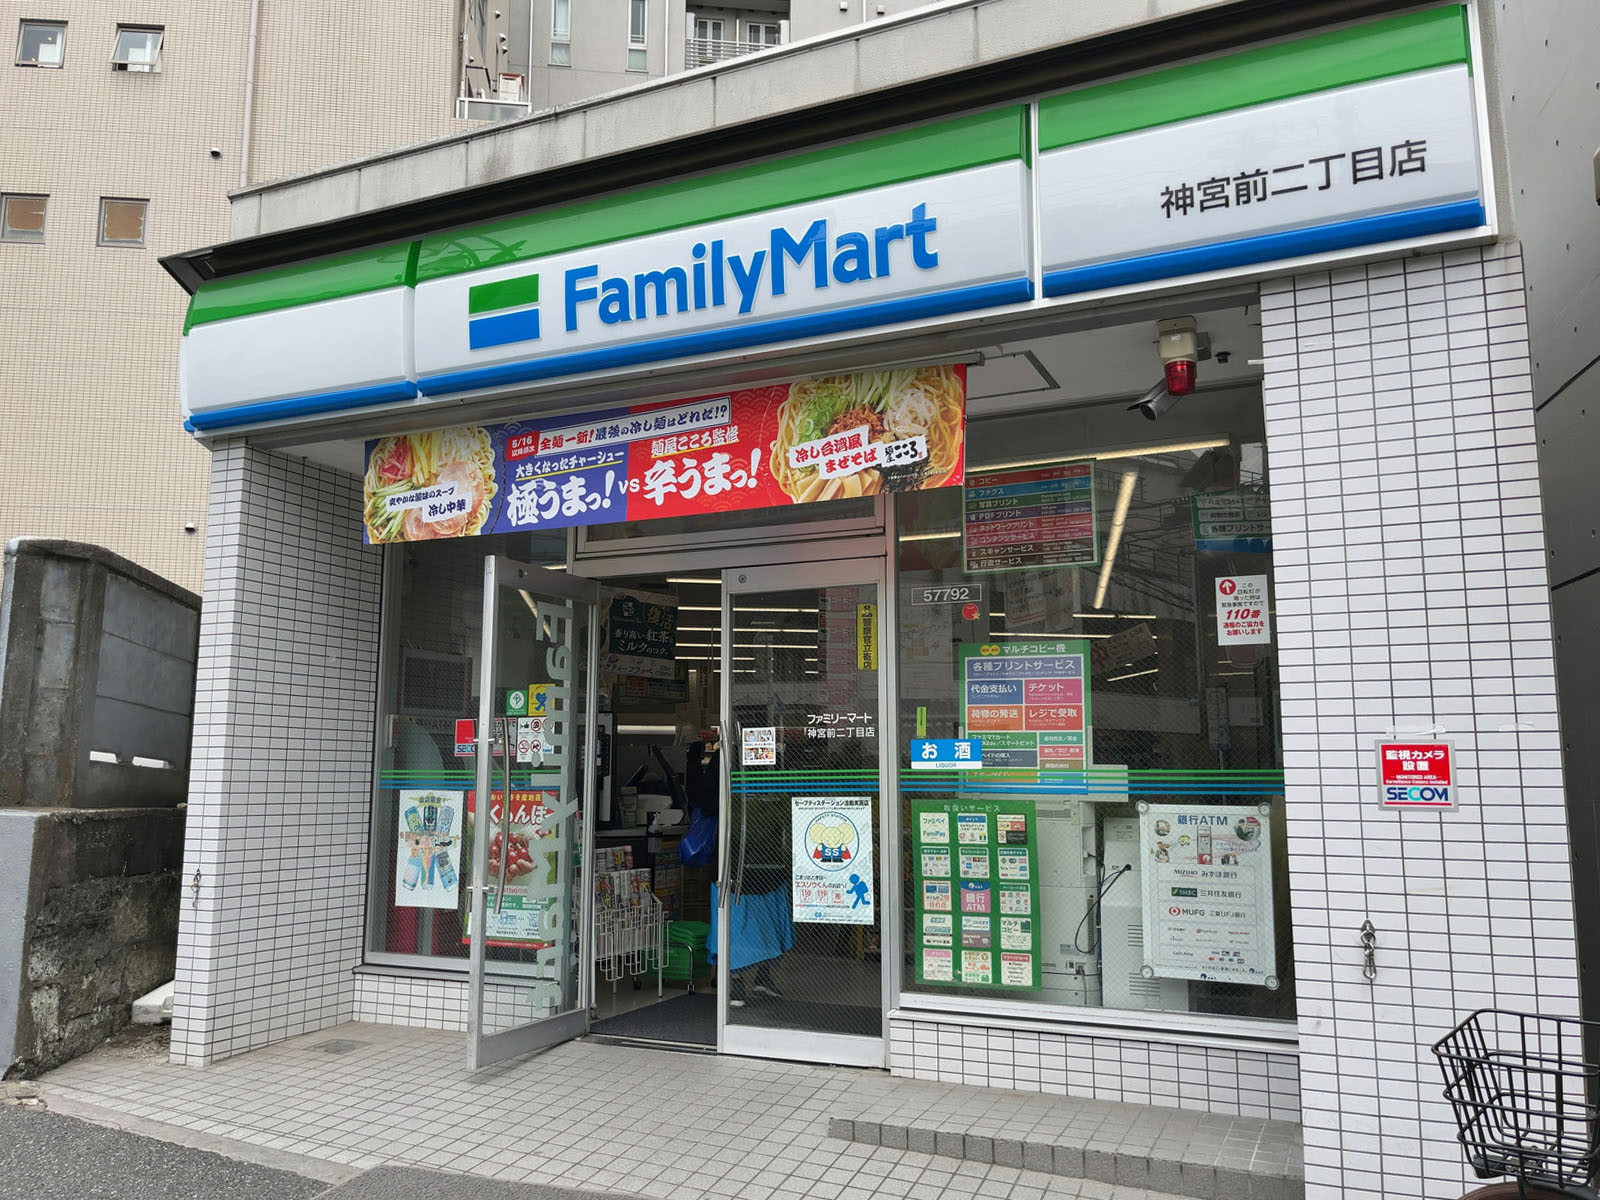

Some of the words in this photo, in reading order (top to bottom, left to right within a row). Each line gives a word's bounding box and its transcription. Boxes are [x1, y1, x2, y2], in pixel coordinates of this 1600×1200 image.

[1160, 139, 1427, 218] 神宮前二丁目店
[565, 202, 938, 332] FamilyMart
[512, 436, 532, 448] 5/16
[795, 433, 862, 463] 冷し台湾風
[516, 451, 624, 478] 大きくなったチャーシュー
[825, 447, 878, 474] まぜそば
[428, 498, 466, 517] 冷し中華
[979, 510, 1021, 520] PDFプリント
[923, 587, 969, 602] 57792
[1225, 608, 1261, 620] 110番
[1226, 628, 1262, 636] お願いします
[1002, 643, 1066, 654] マルチコピー機
[973, 659, 1075, 672] 各種プリントサービス
[971, 684, 1017, 694] 代金支払い
[1029, 683, 1064, 692] チケット
[807, 713, 873, 724] ファミリーマート
[971, 709, 1019, 719] 荷物の発送
[1029, 708, 1077, 718] レジで受取
[807, 727, 875, 738] 神宮前二丁目店
[1385, 750, 1445, 760] 監視カメラ
[1402, 761, 1429, 771] 設置
[1386, 786, 1449, 801] SECOM
[1177, 814, 1228, 826] 銀行ATM
[824, 848, 840, 856] SS
[1201, 870, 1238, 879] みずほ銀行
[966, 892, 985, 901] 銀行
[1200, 889, 1242, 899] 三井住友銀行
[966, 903, 985, 911] ATM
[1181, 908, 1205, 917] MUFG
